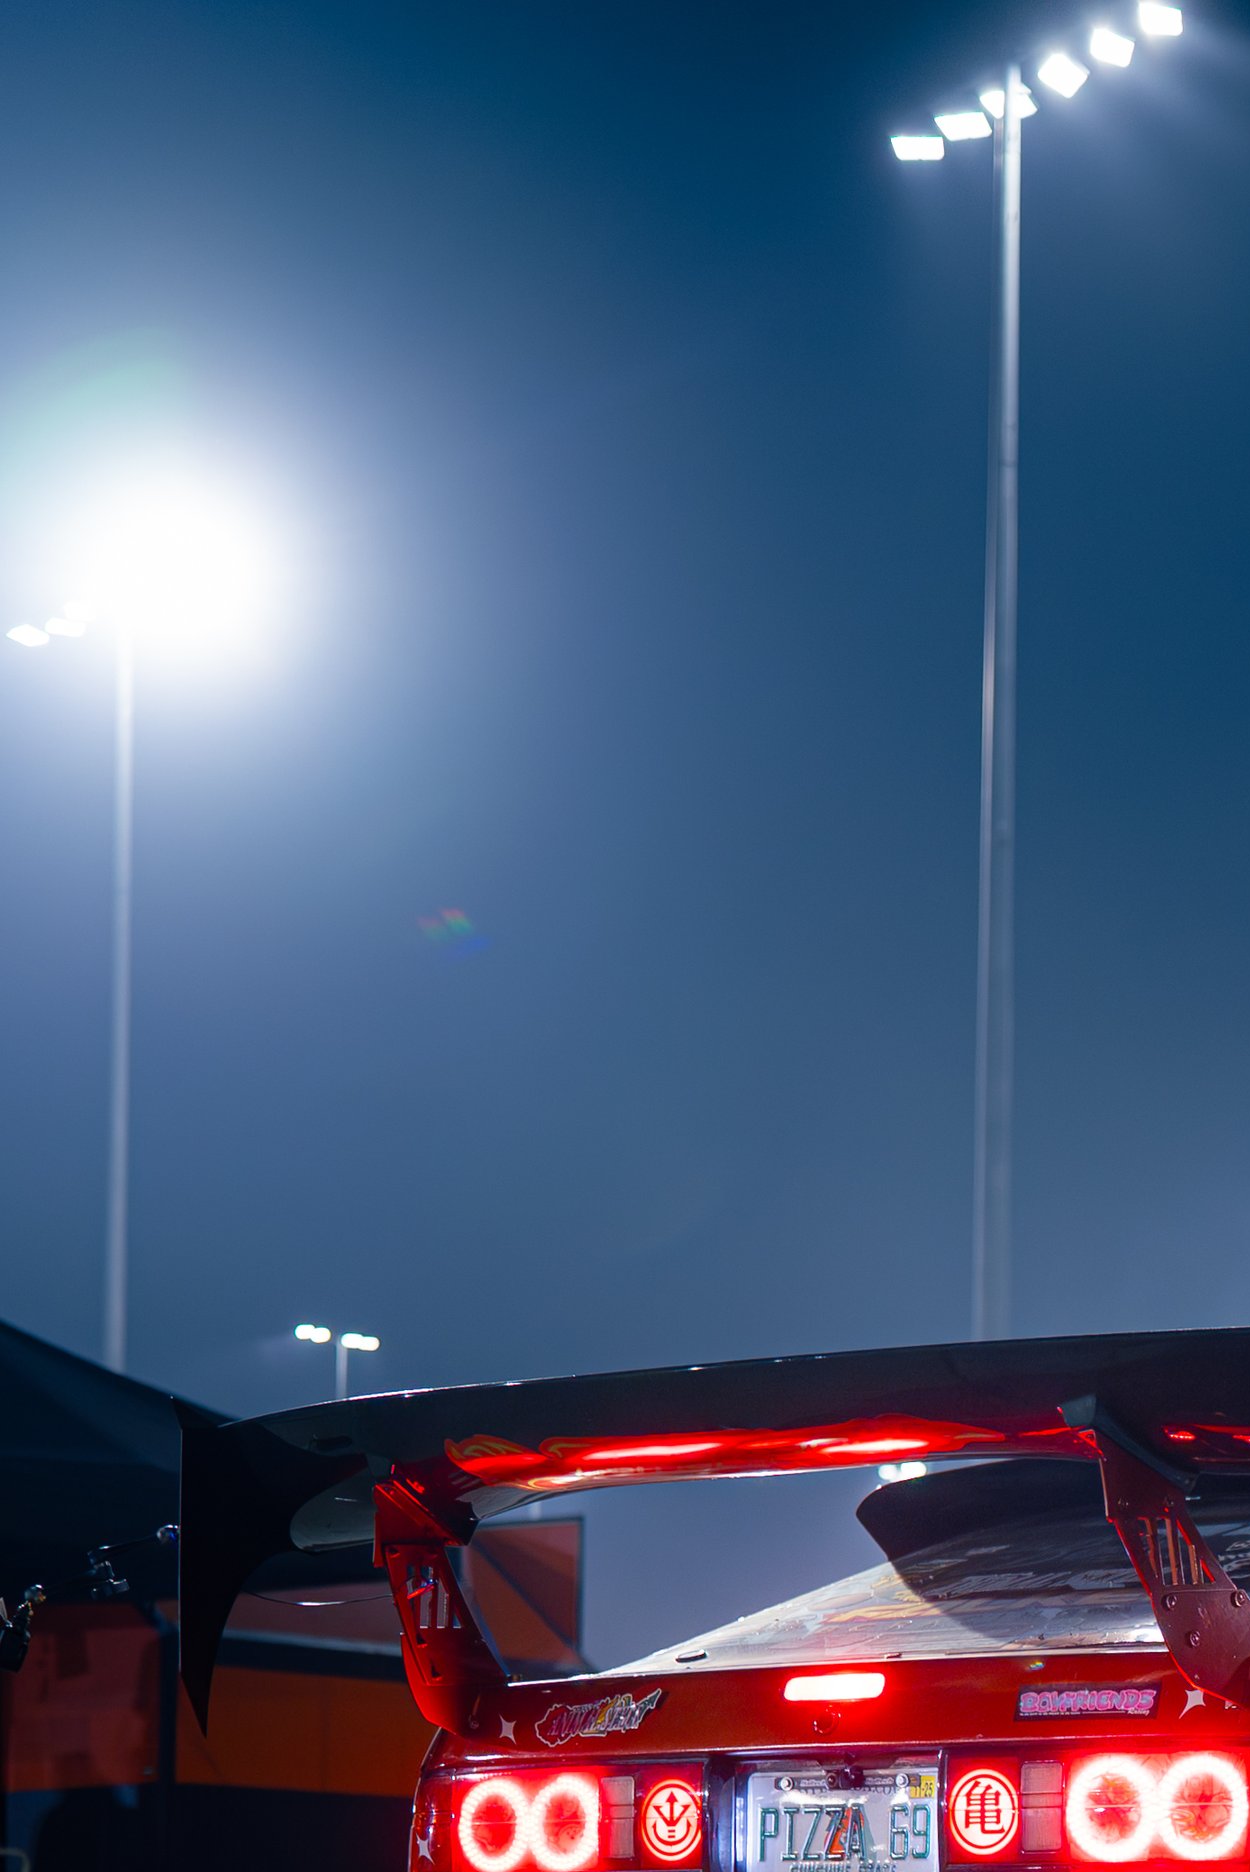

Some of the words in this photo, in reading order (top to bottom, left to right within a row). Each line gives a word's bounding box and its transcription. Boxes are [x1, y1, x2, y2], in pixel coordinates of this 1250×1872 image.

[1020, 1689, 1157, 1712] BOYFRIENDS
[759, 1803, 866, 1862] PIZZA
[889, 1803, 932, 1861] 69
[963, 1781, 1006, 1836] 亀
